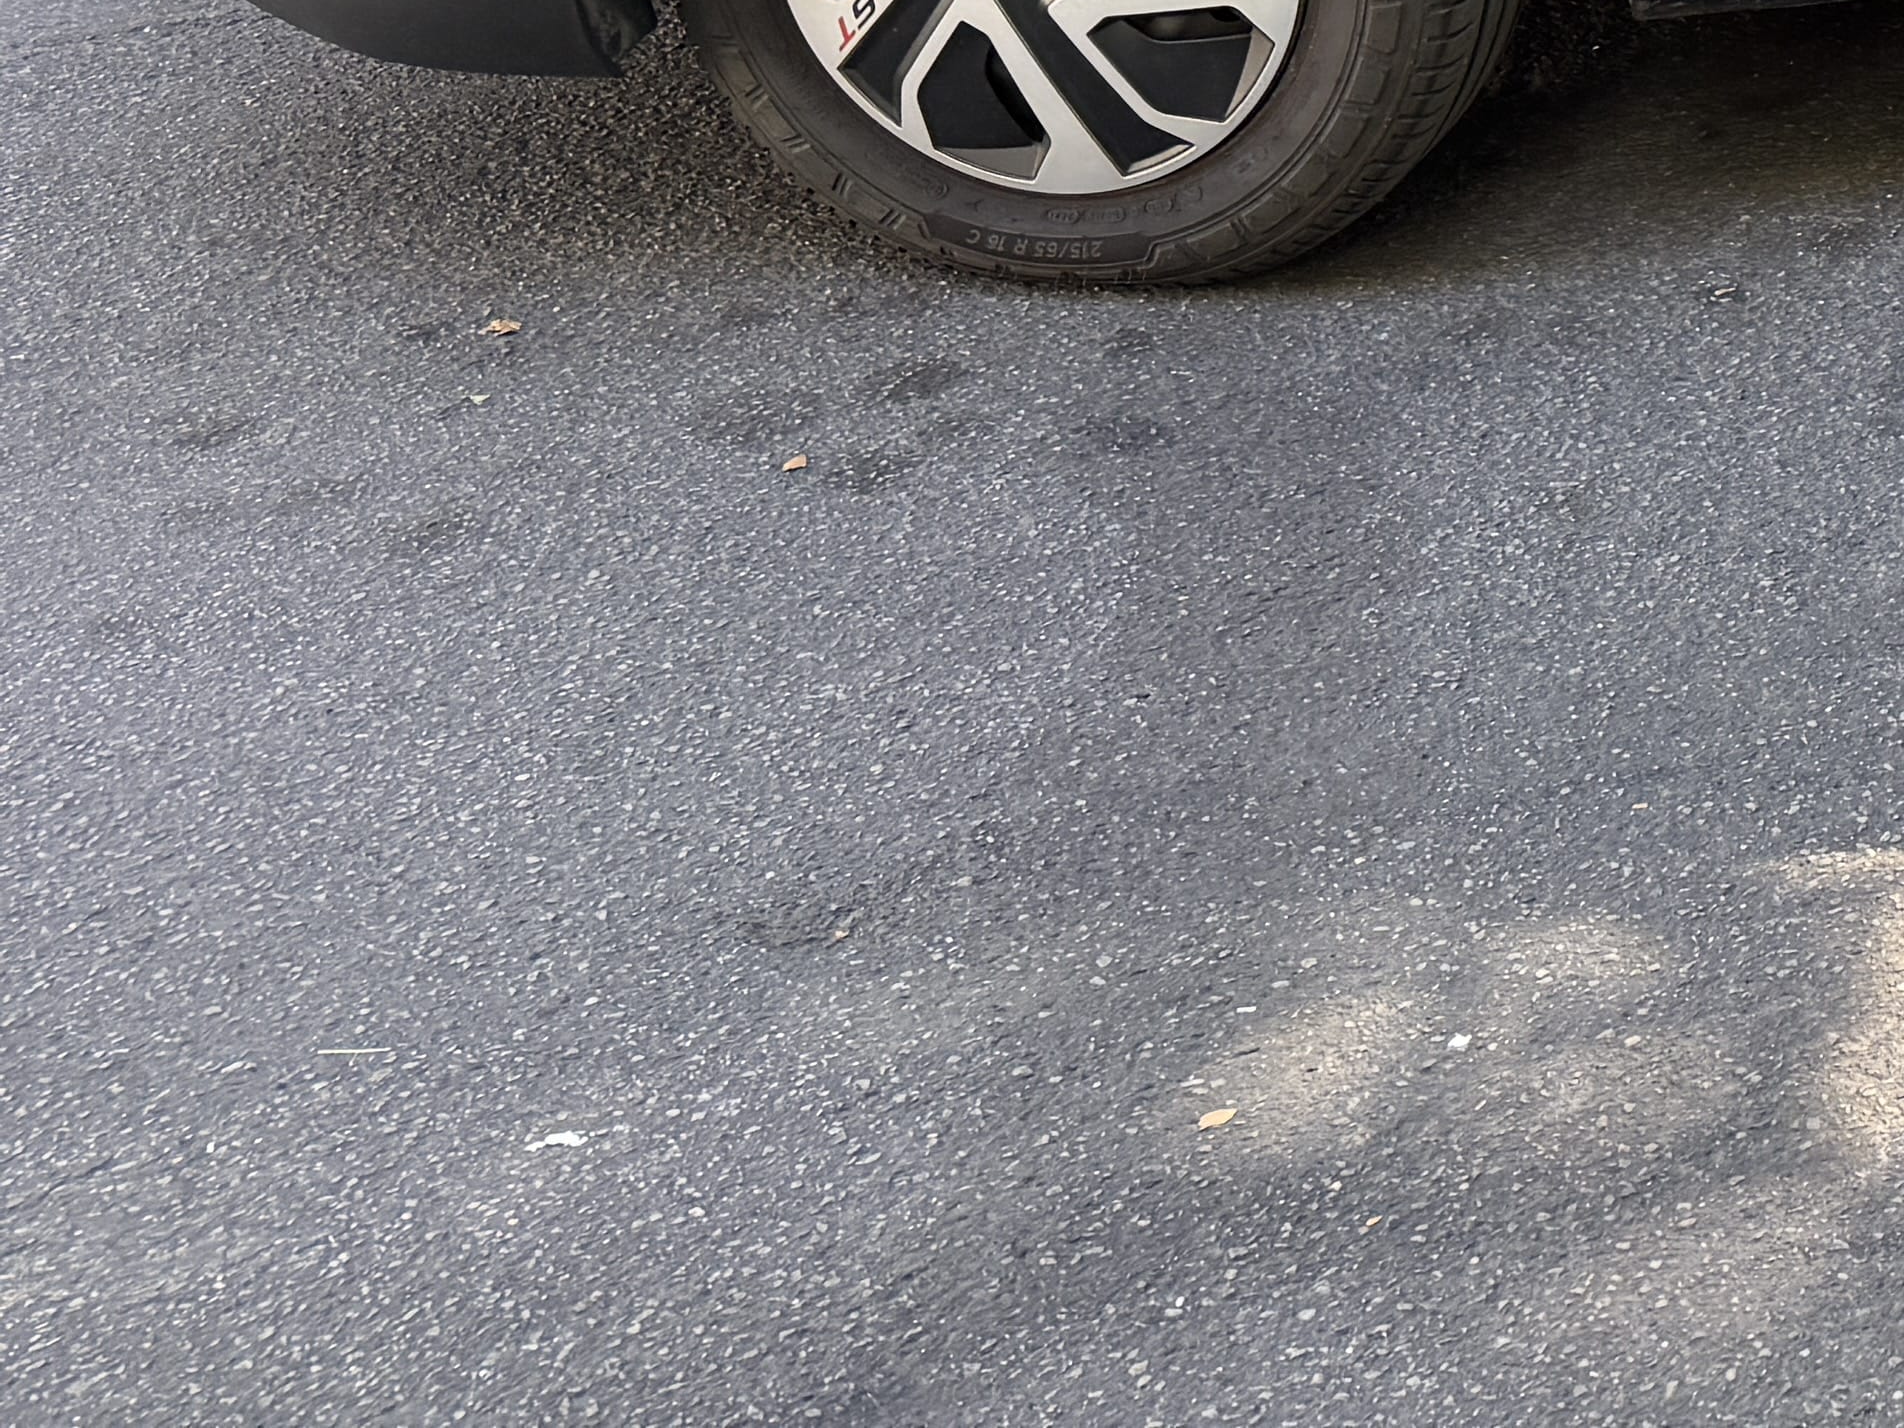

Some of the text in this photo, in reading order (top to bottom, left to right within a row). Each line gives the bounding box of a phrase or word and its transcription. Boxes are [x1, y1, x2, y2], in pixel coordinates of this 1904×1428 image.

[965, 229, 1103, 259] 215/65 R 16 C
